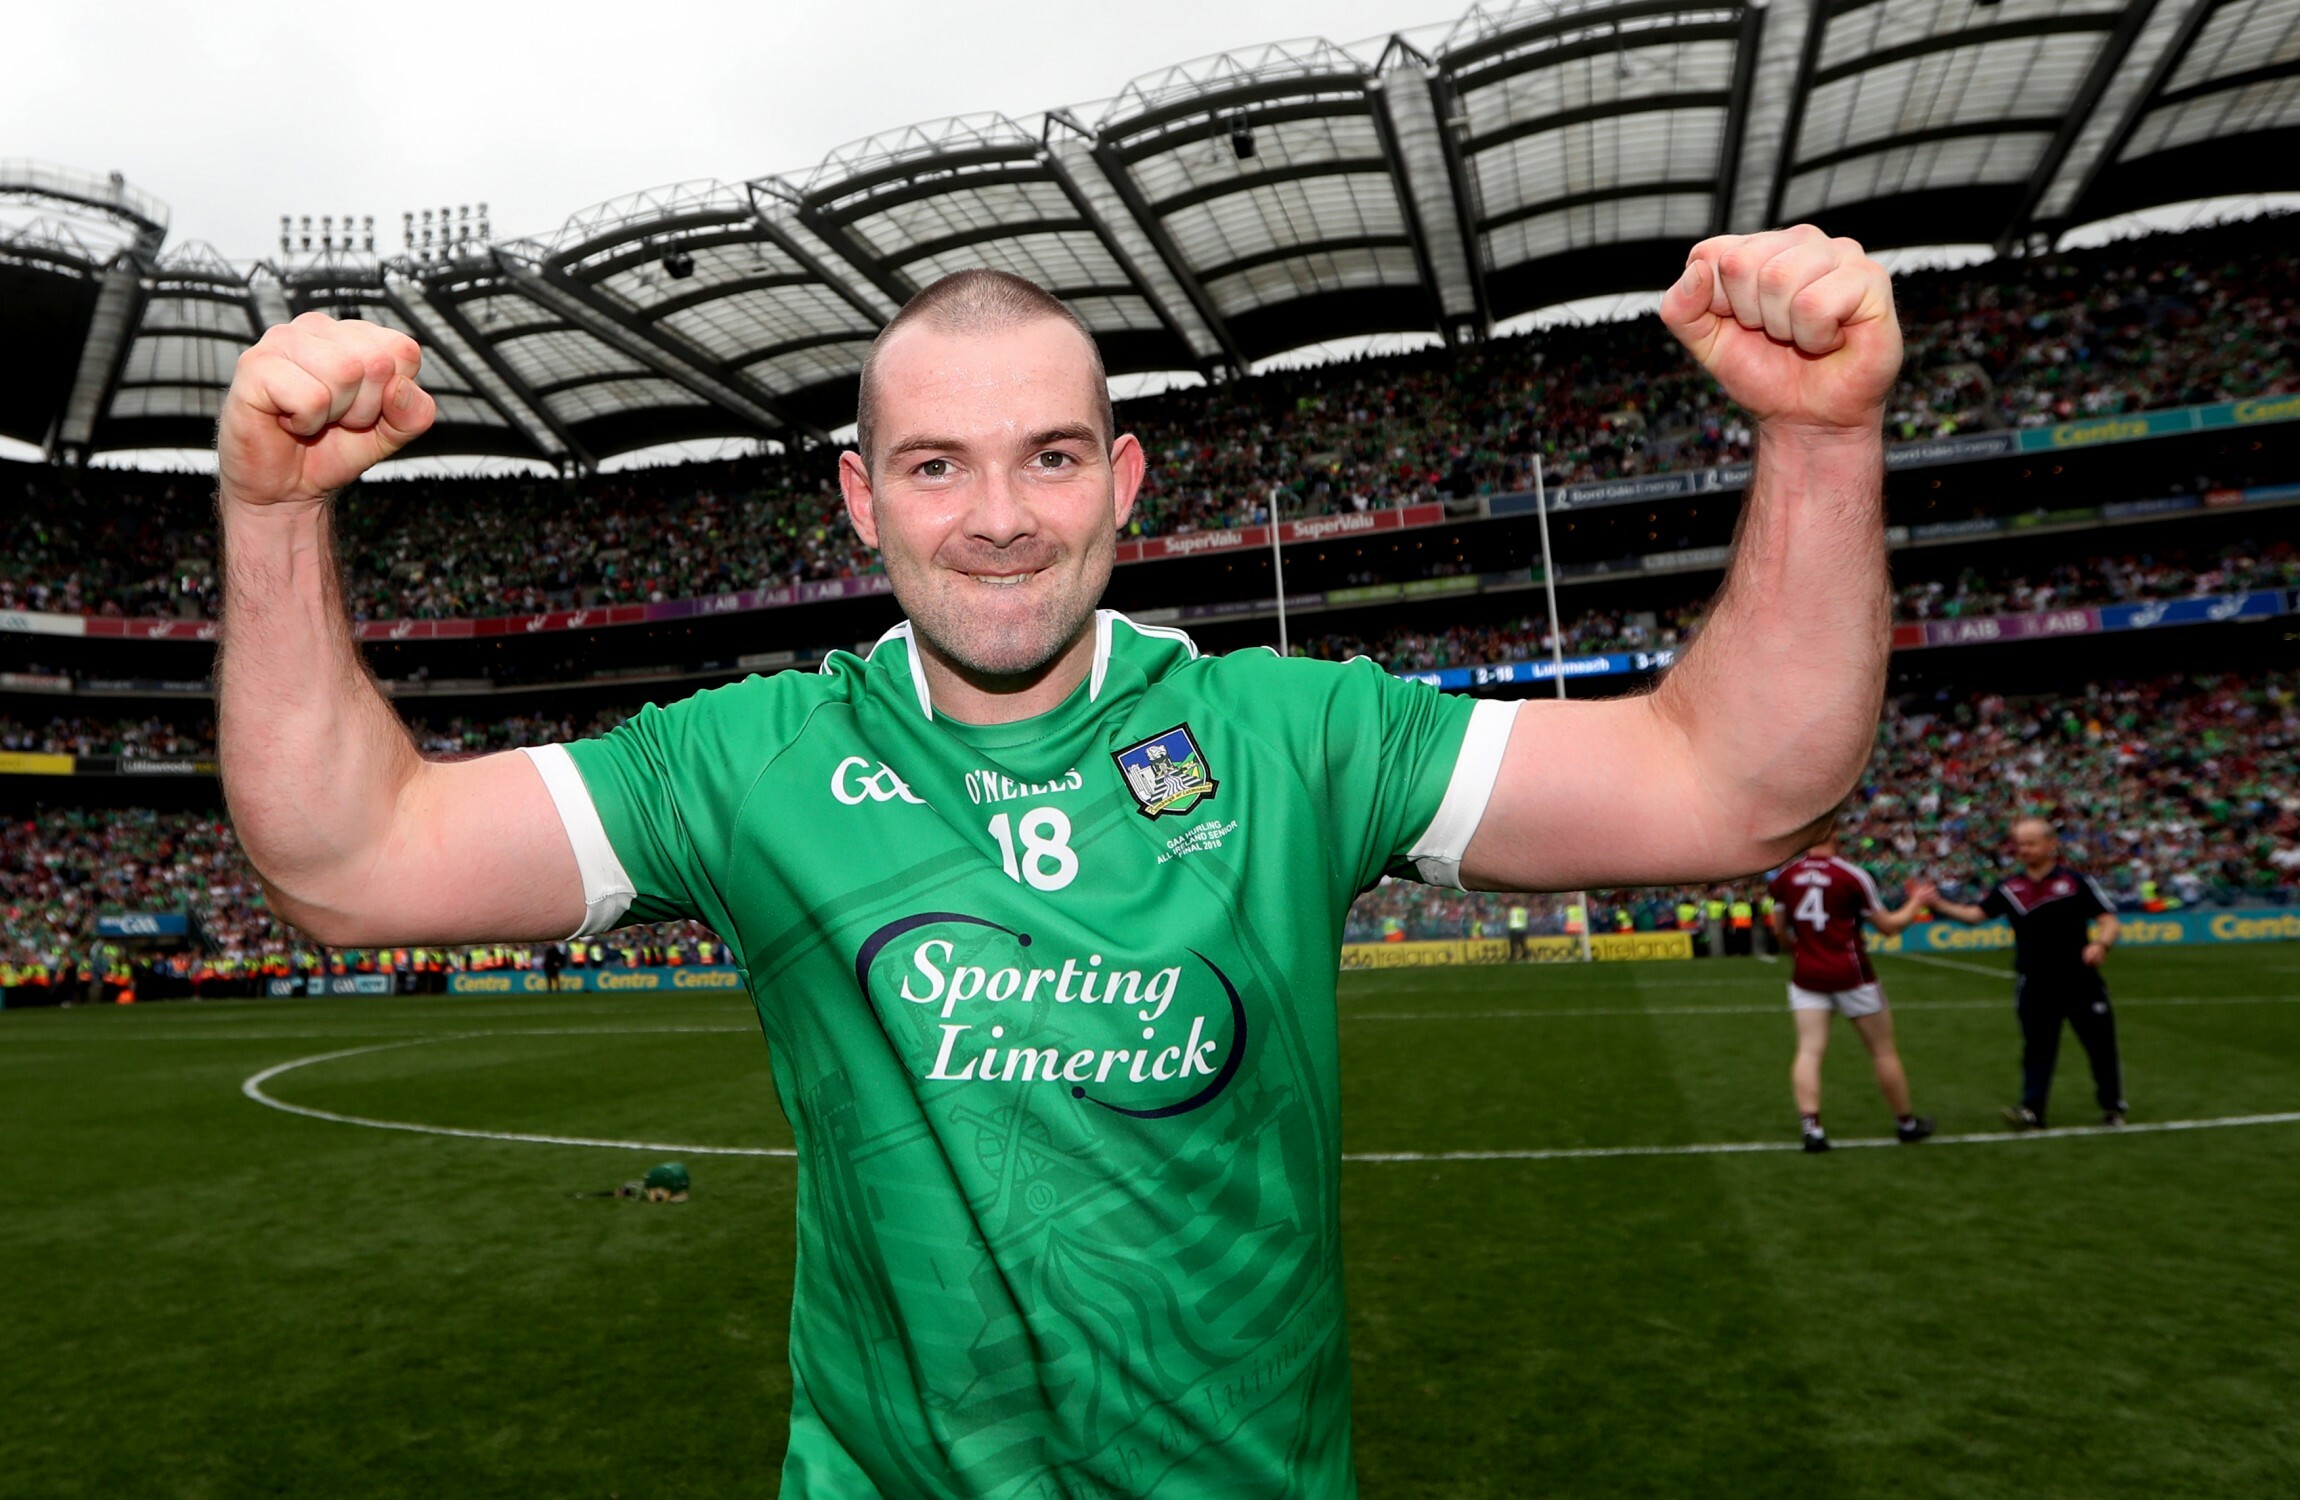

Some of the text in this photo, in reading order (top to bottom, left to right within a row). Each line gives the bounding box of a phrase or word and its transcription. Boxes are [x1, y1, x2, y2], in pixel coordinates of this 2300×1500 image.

[2052, 418, 2149, 446] Centra
[1294, 514, 1375, 538] SuperValu
[1164, 531, 1243, 554] SuperValu
[766, 589, 791, 604] AIB
[818, 582, 844, 597] AIB
[714, 597, 739, 610] AIB
[1960, 618, 2000, 641] AIB
[2047, 610, 2088, 634] AIB
[1156, 820, 1238, 865] ALL IRELAND SENIOR
[1166, 820, 1222, 849] GAA HURLING
[988, 806, 1080, 892] 18
[1178, 839, 1222, 859] FINAL 2018
[1794, 886, 1830, 932] 4
[1928, 924, 2016, 949] Cent
[453, 974, 511, 992] Centra
[523, 972, 583, 992] Cetra
[597, 970, 659, 990] Centra
[673, 968, 738, 988] Centra
[900, 939, 1182, 1021] Sporting
[925, 1015, 1218, 1083] Limerick
